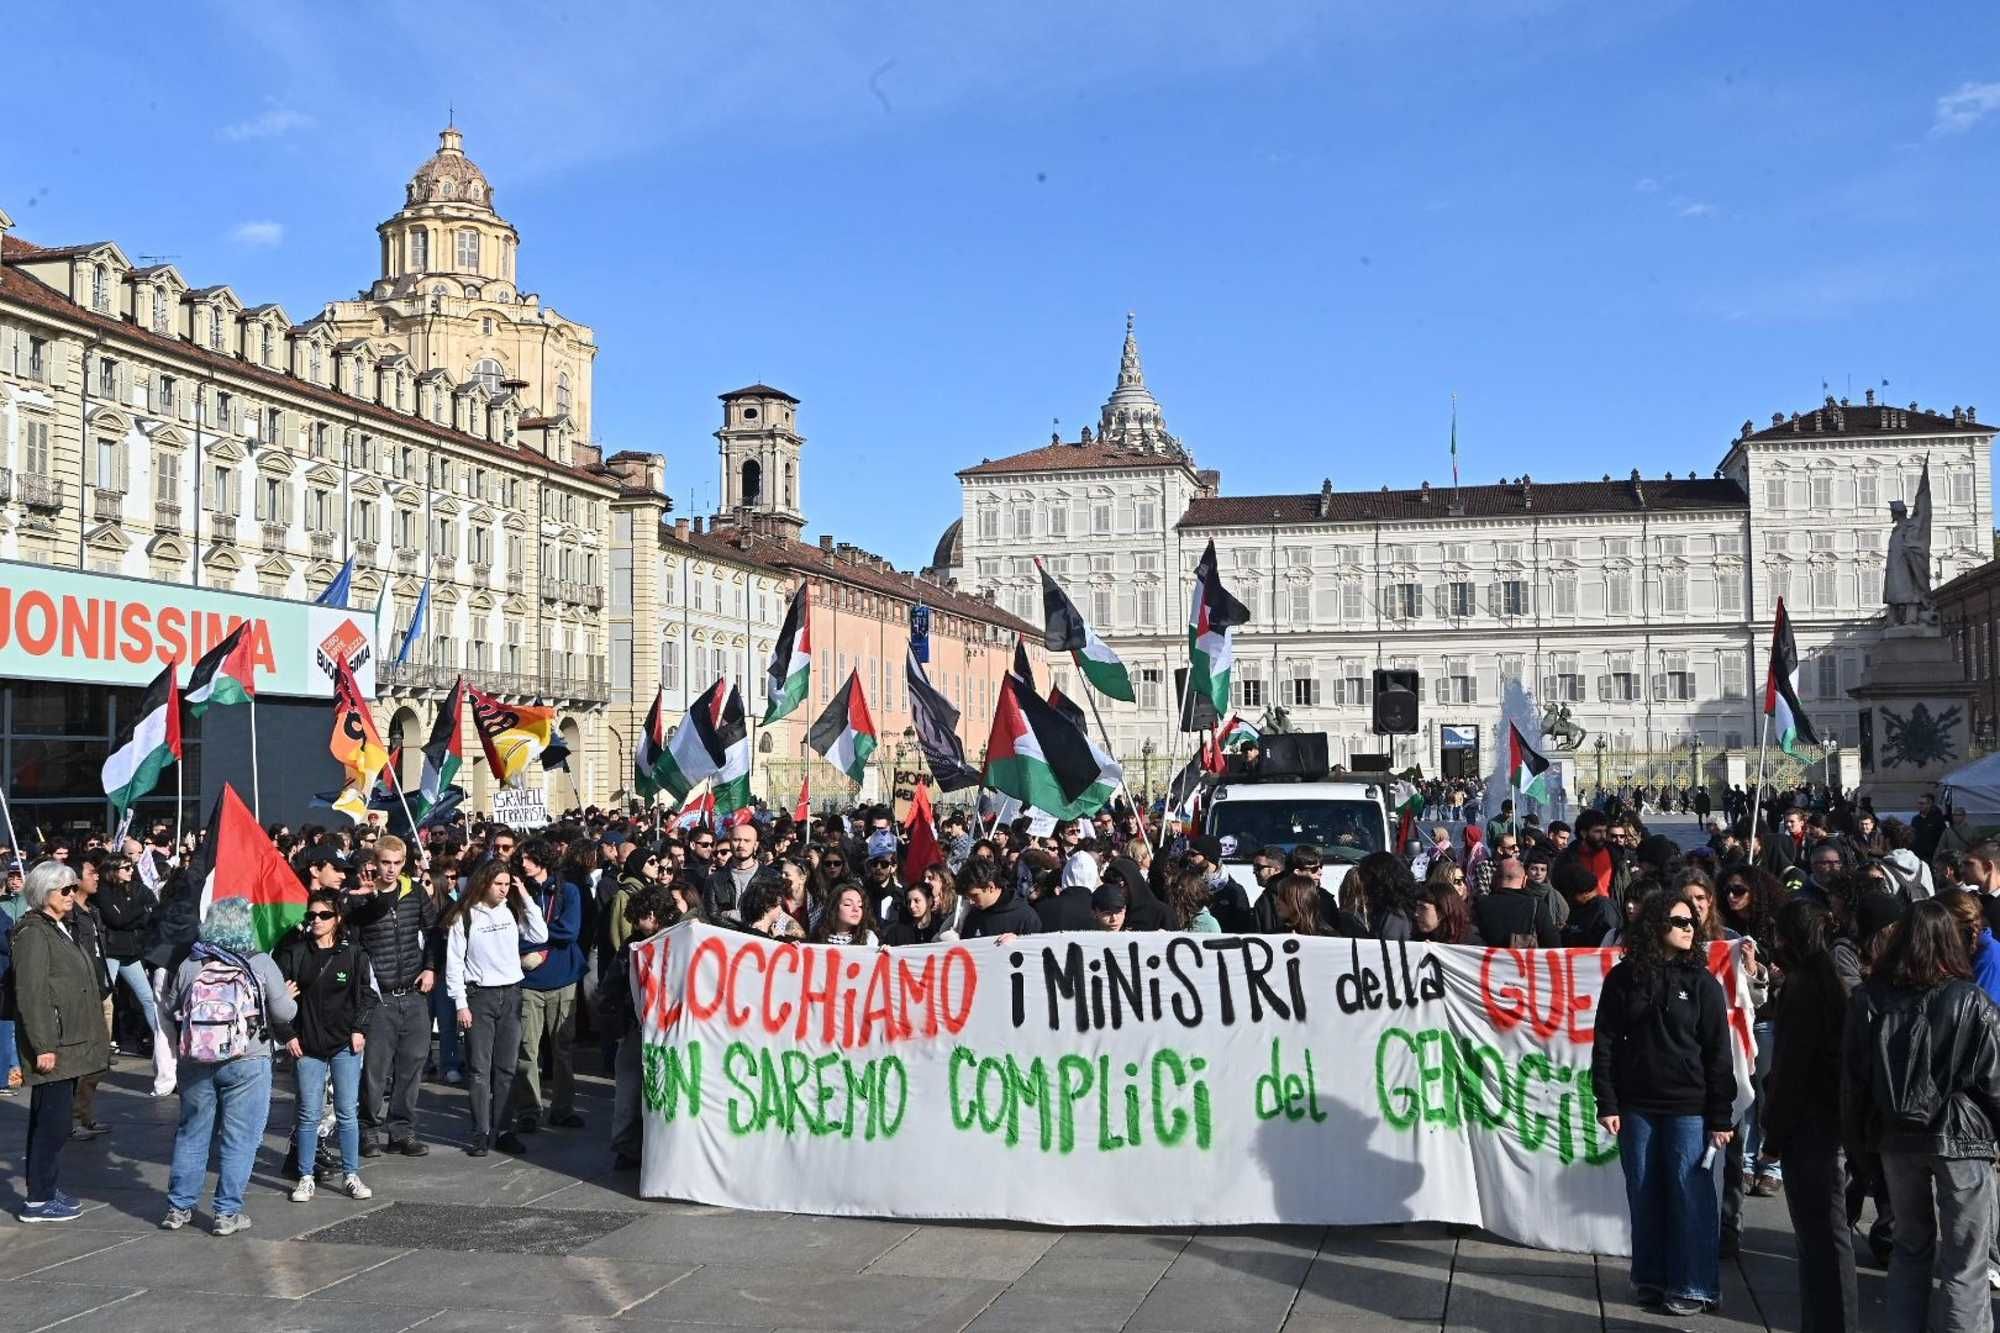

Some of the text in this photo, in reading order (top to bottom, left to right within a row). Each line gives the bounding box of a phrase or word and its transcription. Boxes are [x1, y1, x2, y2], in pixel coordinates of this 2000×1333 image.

[0, 587, 276, 673] ONISSIMA
[1336, 938, 1446, 1014] della
[643, 1039, 703, 1122] ON
[722, 1041, 908, 1142] SAREMO
[1255, 1036, 1328, 1122] del
